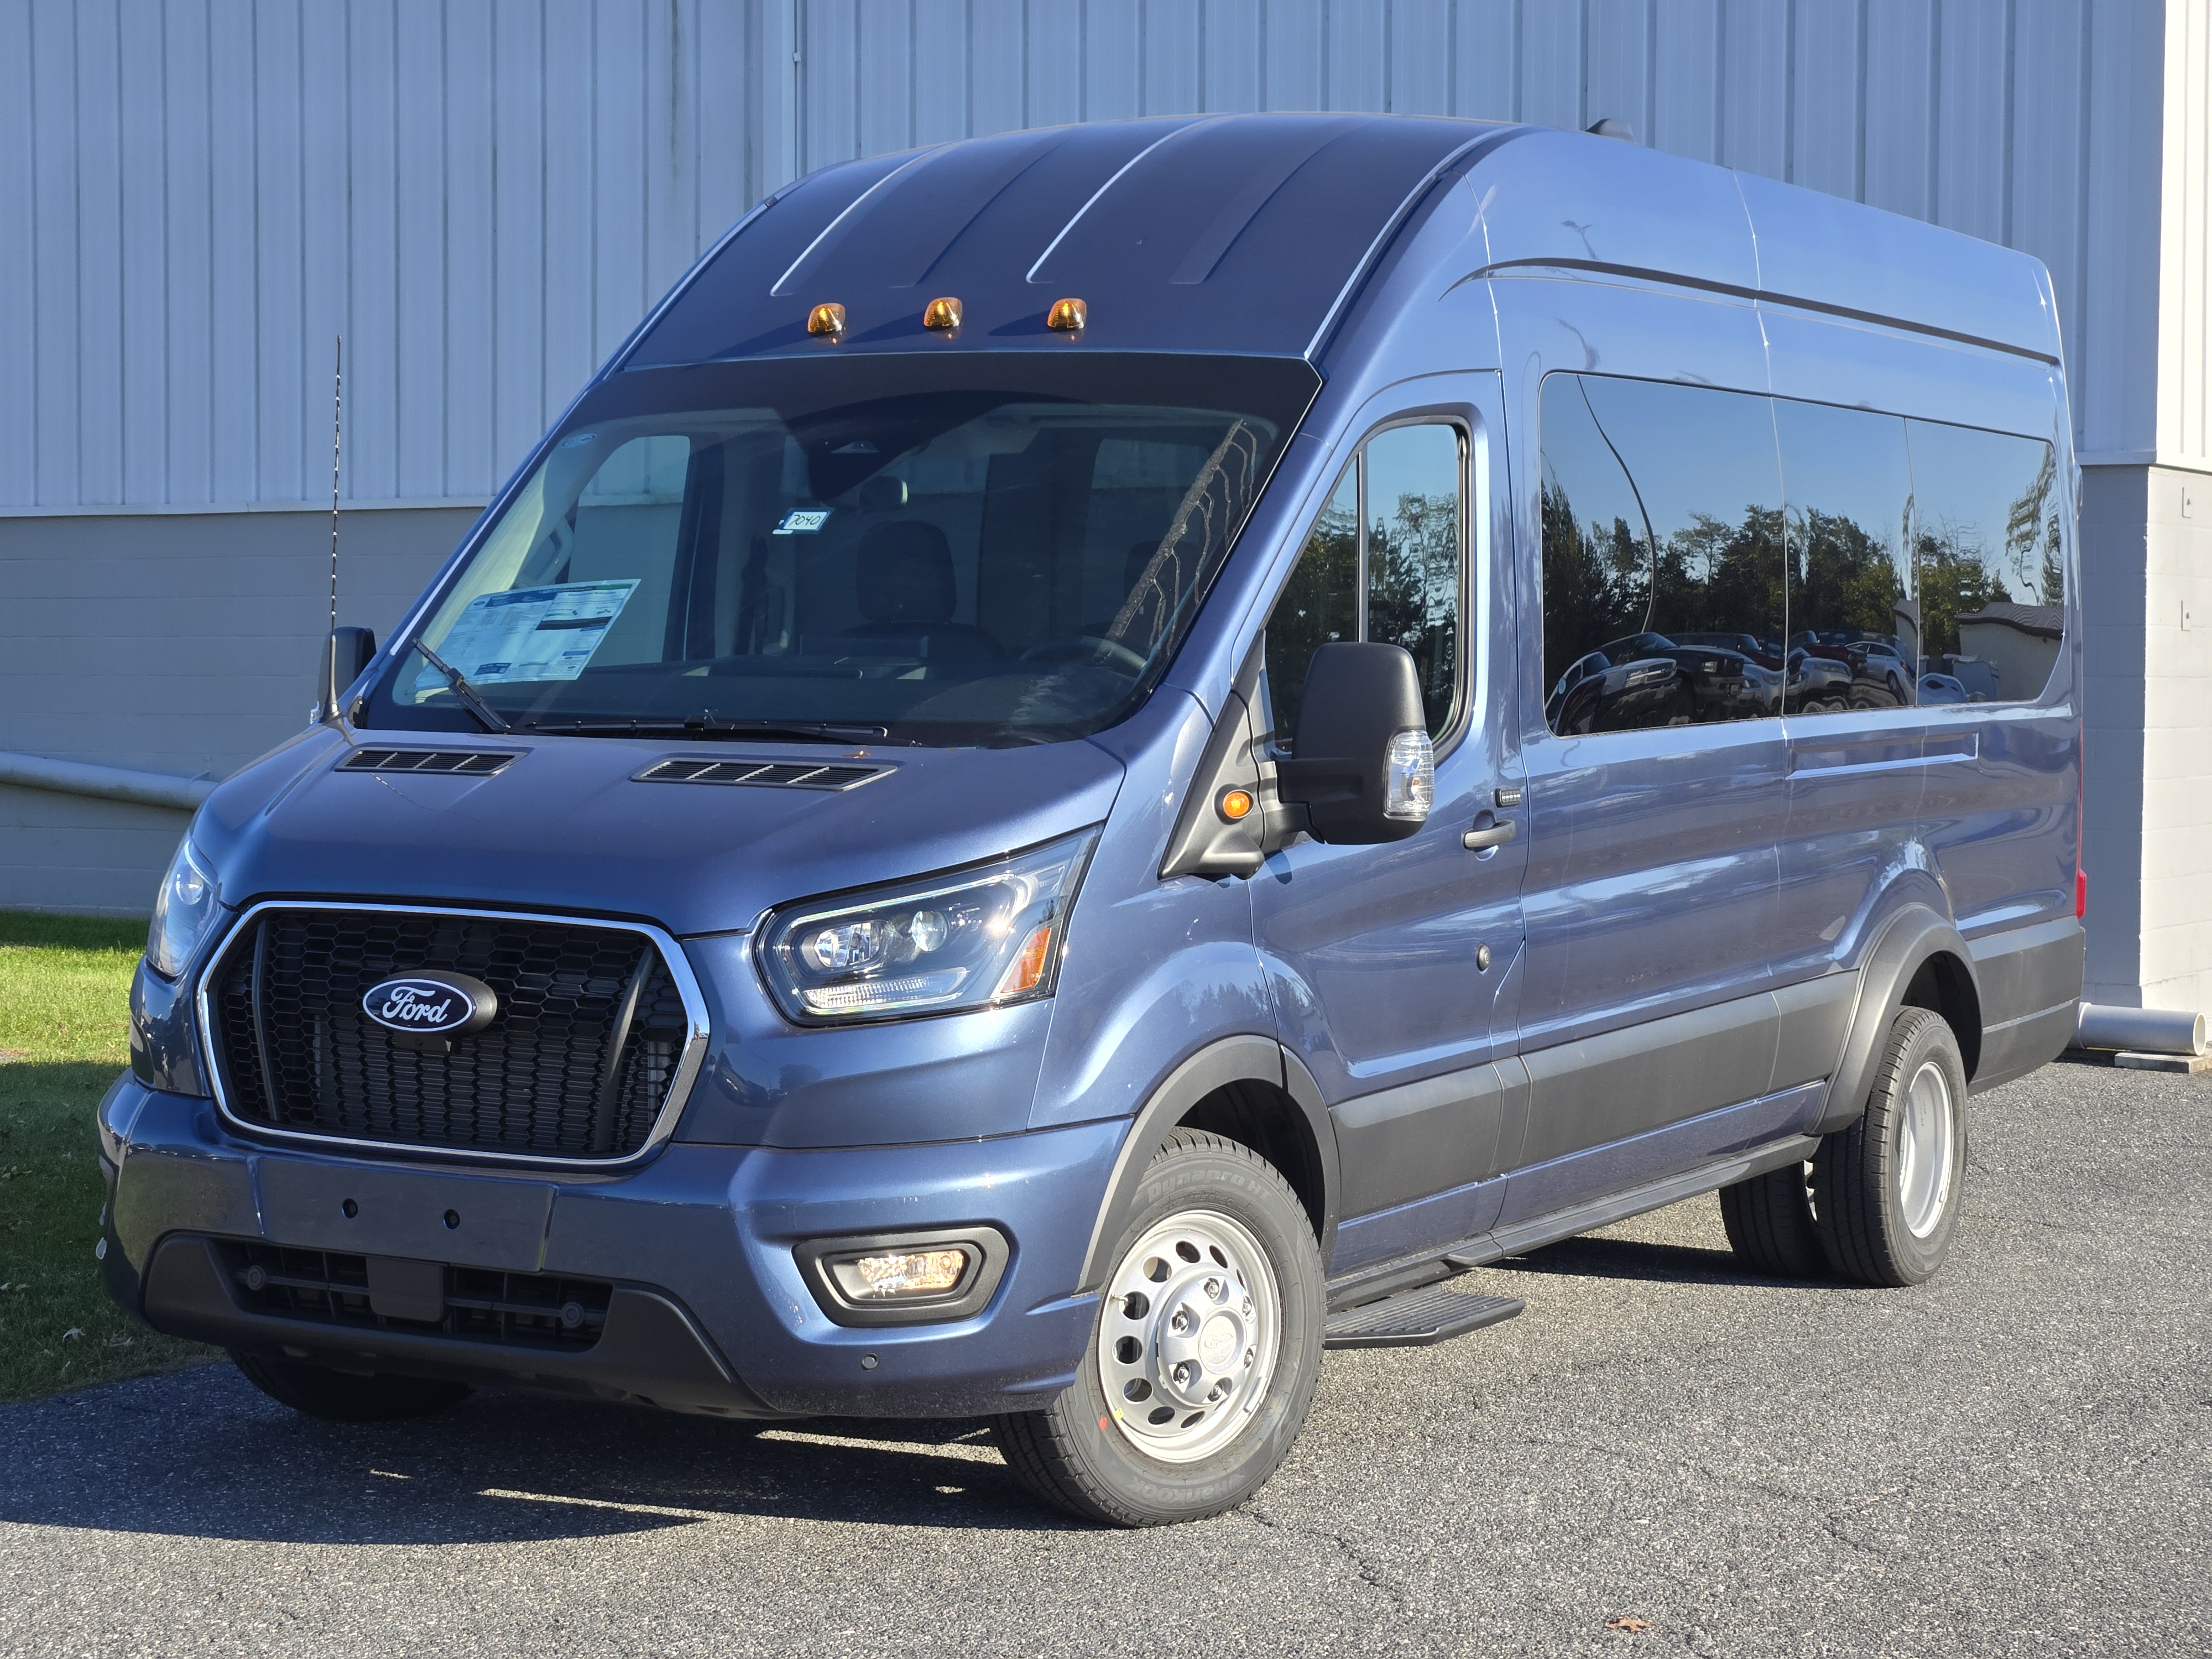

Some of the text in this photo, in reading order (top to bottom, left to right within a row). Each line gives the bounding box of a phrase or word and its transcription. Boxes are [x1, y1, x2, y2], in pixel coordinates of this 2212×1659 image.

[789, 514, 821, 526] 7040
[383, 986, 451, 1023] Ford
[1147, 1170, 1272, 1202] Dynapro HT
